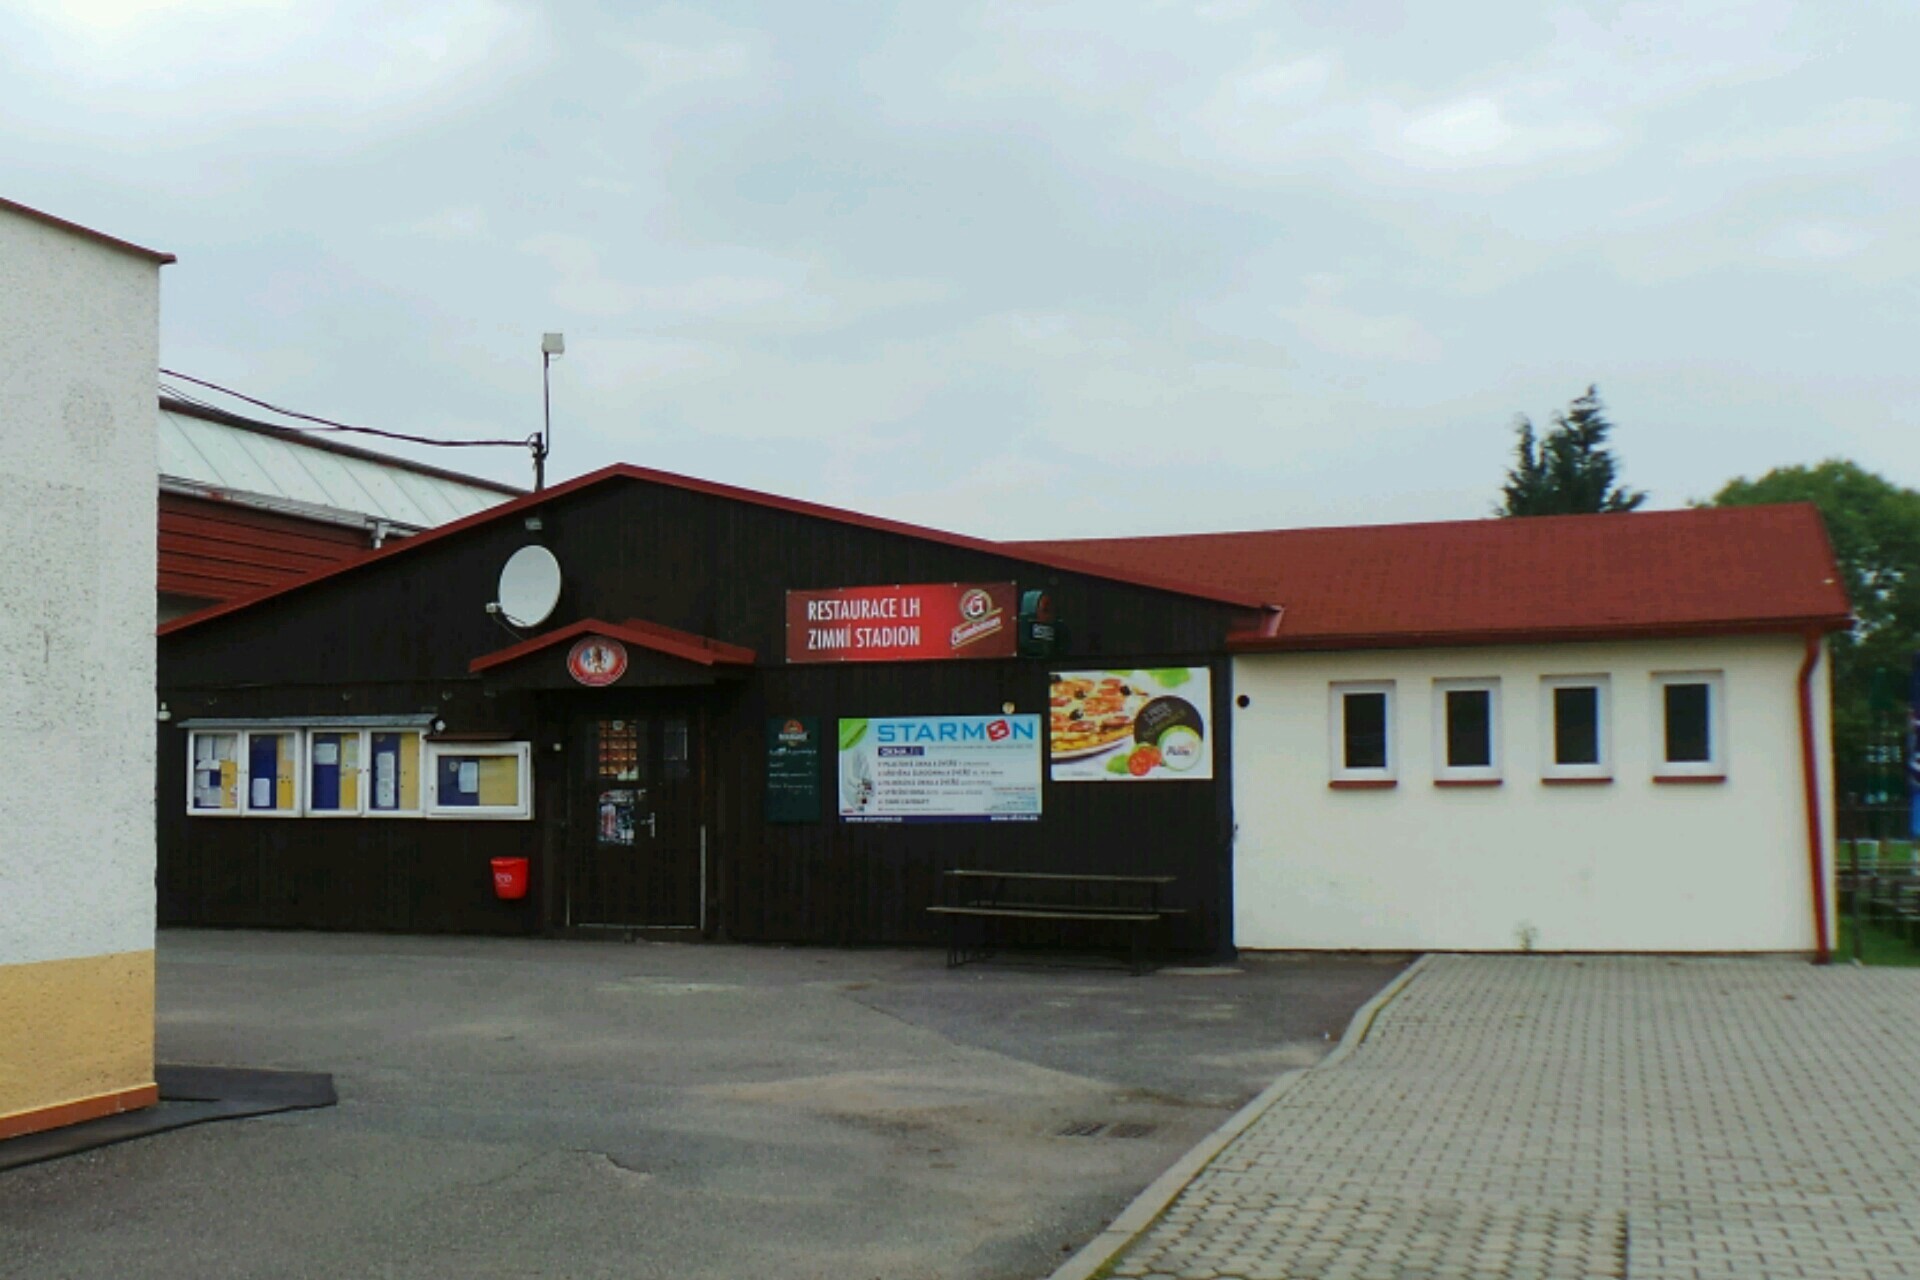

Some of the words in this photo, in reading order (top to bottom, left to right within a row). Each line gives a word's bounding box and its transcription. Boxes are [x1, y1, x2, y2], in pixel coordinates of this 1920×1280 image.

[807, 598, 898, 621] RESTAURACE
[902, 597, 921, 619] LH
[807, 623, 852, 650] ZIMNÍ
[856, 625, 921, 648] STADION
